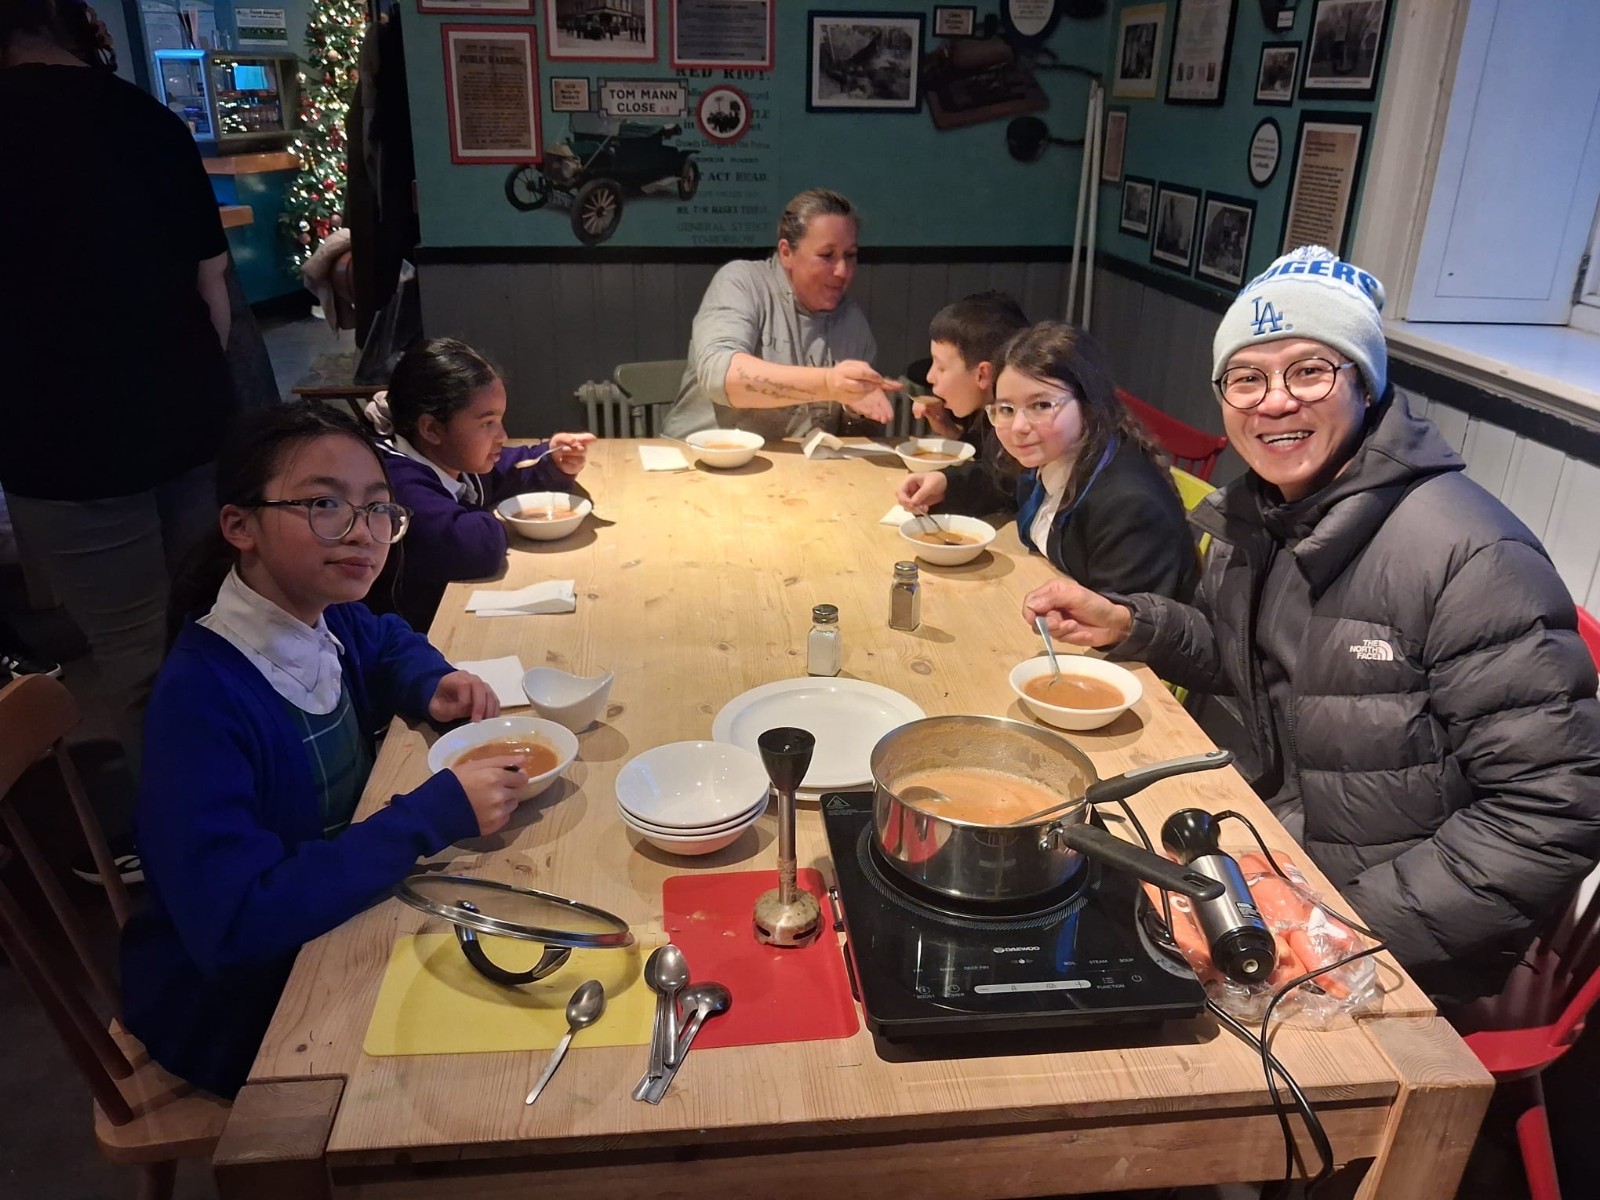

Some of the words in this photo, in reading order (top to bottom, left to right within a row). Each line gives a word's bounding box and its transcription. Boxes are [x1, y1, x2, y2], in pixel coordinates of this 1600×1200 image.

[609, 89, 636, 101] TOM
[641, 89, 678, 101] MANN
[617, 102, 656, 113] CLOSE
[1251, 297, 1284, 336] LA
[1362, 639, 1379, 647] THE
[1356, 653, 1378, 661] FACE
